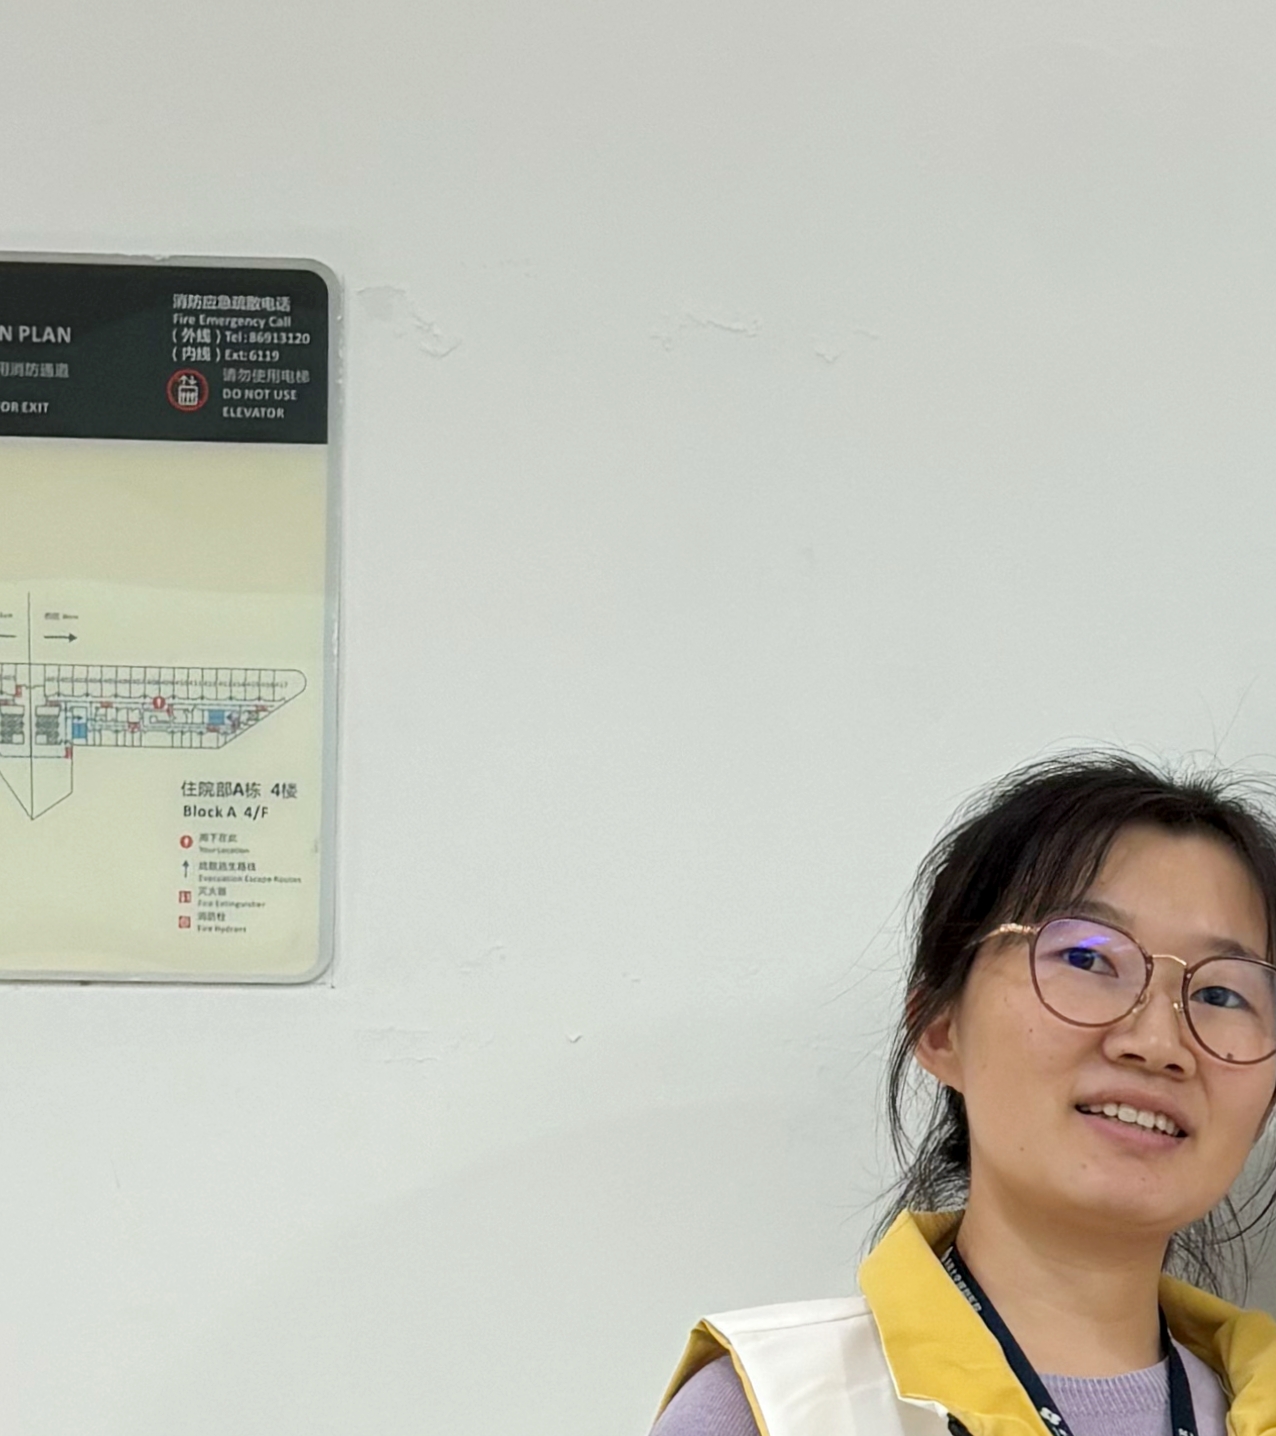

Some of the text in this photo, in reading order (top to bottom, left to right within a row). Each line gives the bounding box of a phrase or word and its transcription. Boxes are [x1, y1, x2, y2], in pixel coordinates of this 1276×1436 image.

[172, 313, 292, 329] Fire Emergency Call
[19, 325, 72, 343] PLAN
[222, 367, 311, 384] 请勿使用电梯
[222, 388, 298, 401] DO NOT USE
[22, 401, 50, 414] EXIT
[222, 406, 285, 418] ELEVATOR
[181, 780, 299, 800] 住院部A栋 4楼
[183, 805, 269, 821] Block A 4/F
